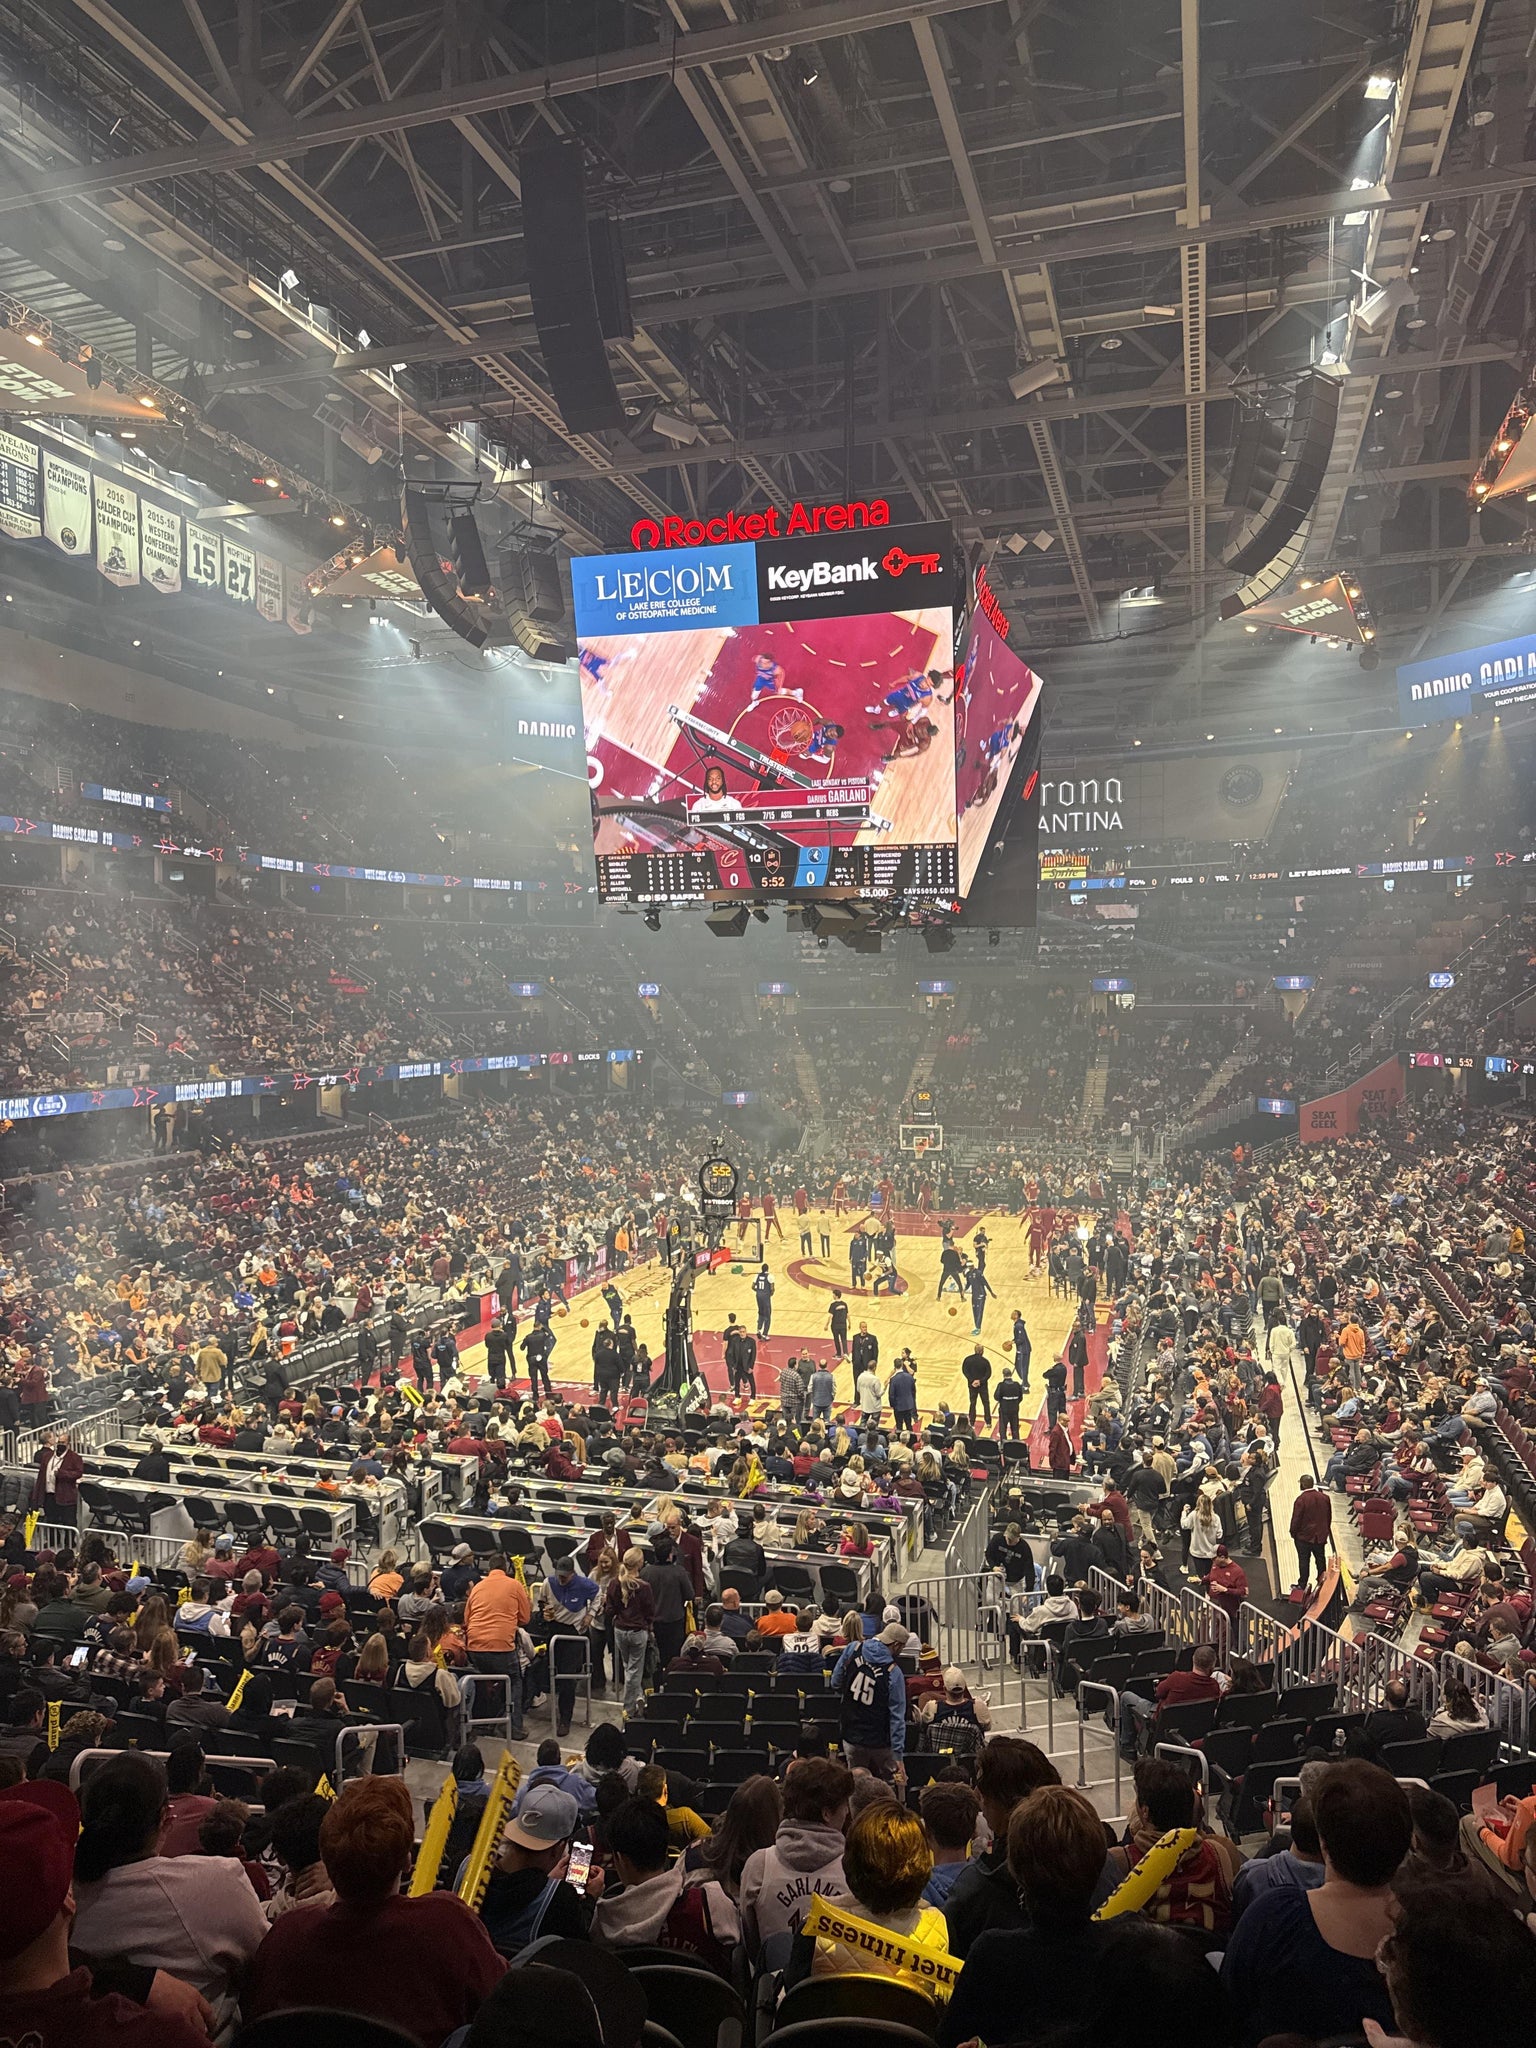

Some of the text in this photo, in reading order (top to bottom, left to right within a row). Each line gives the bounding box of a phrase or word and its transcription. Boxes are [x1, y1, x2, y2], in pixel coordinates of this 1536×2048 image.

[47, 469, 88, 495] CHAMPIONS
[106, 488, 125, 505] 2016
[96, 498, 136, 523] CALDER CUP
[147, 509, 175, 530] 2015-16
[97, 512, 136, 537] CHAMPIONS
[663, 499, 889, 548] Rocket Arena
[148, 524, 175, 543] WESTERN
[144, 535, 179, 557] CONFERENCE
[146, 547, 179, 568] CHAMPIONS
[193, 543, 216, 581] 15
[228, 559, 251, 597] 27
[768, 557, 879, 592] KeyBank
[616, 605, 718, 621] OF OSTEOPATHIC MEDICINE
[629, 598, 701, 611] LAKE ERIE COLLEGE
[1280, 598, 1333, 619] LET EM
[1288, 604, 1344, 626] KNOW.
[1484, 691, 1500, 699] YOUR
[1495, 698, 1514, 707] ENJOY
[758, 753, 796, 779] TRUSTEDSEC
[103, 787, 121, 802] DARIUS
[121, 791, 142, 807] GARLAND
[807, 789, 867, 804] DARIUS GARLAND
[1042, 778, 1124, 807] rona
[763, 811, 776, 820] 7/15
[816, 809, 820, 818] 6
[826, 809, 839, 817] REBS
[863, 808, 867, 817] 2
[1038, 811, 1124, 834] ANTINA
[52, 823, 73, 840] DARIUS
[74, 827, 98, 844] GARLAND
[749, 854, 761, 863] 1Q
[1382, 862, 1402, 874] DARIUS
[1403, 860, 1429, 872] GARLAND
[730, 871, 815, 887] 0 5:52 0
[1049, 868, 1078, 879] Sprite
[1152, 878, 1157, 886] 0
[1288, 870, 1306, 878] LET
[1321, 868, 1351, 876] KNOW.
[606, 893, 628, 901] oswald
[670, 893, 705, 901] RAFFLE
[859, 888, 889, 898] $5,000
[578, 1053, 600, 1061] BLOCKS
[1434, 1056, 1440, 1065] 0
[1459, 1058, 1473, 1067] 5:52
[1489, 1060, 1493, 1069] 0
[175, 1084, 199, 1102] DARIUS
[199, 1081, 226, 1100] GARLAND
[1362, 1089, 1386, 1100] SEAT
[8, 1099, 29, 1117] CAVS
[1311, 1111, 1336, 1120] SEAT
[1311, 1120, 1338, 1129] GEEK
[712, 1166, 732, 1177] 5:52
[758, 1281, 765, 1290] 11
[850, 1672, 876, 1706] 45
[817, 1914, 902, 1966] fitness
